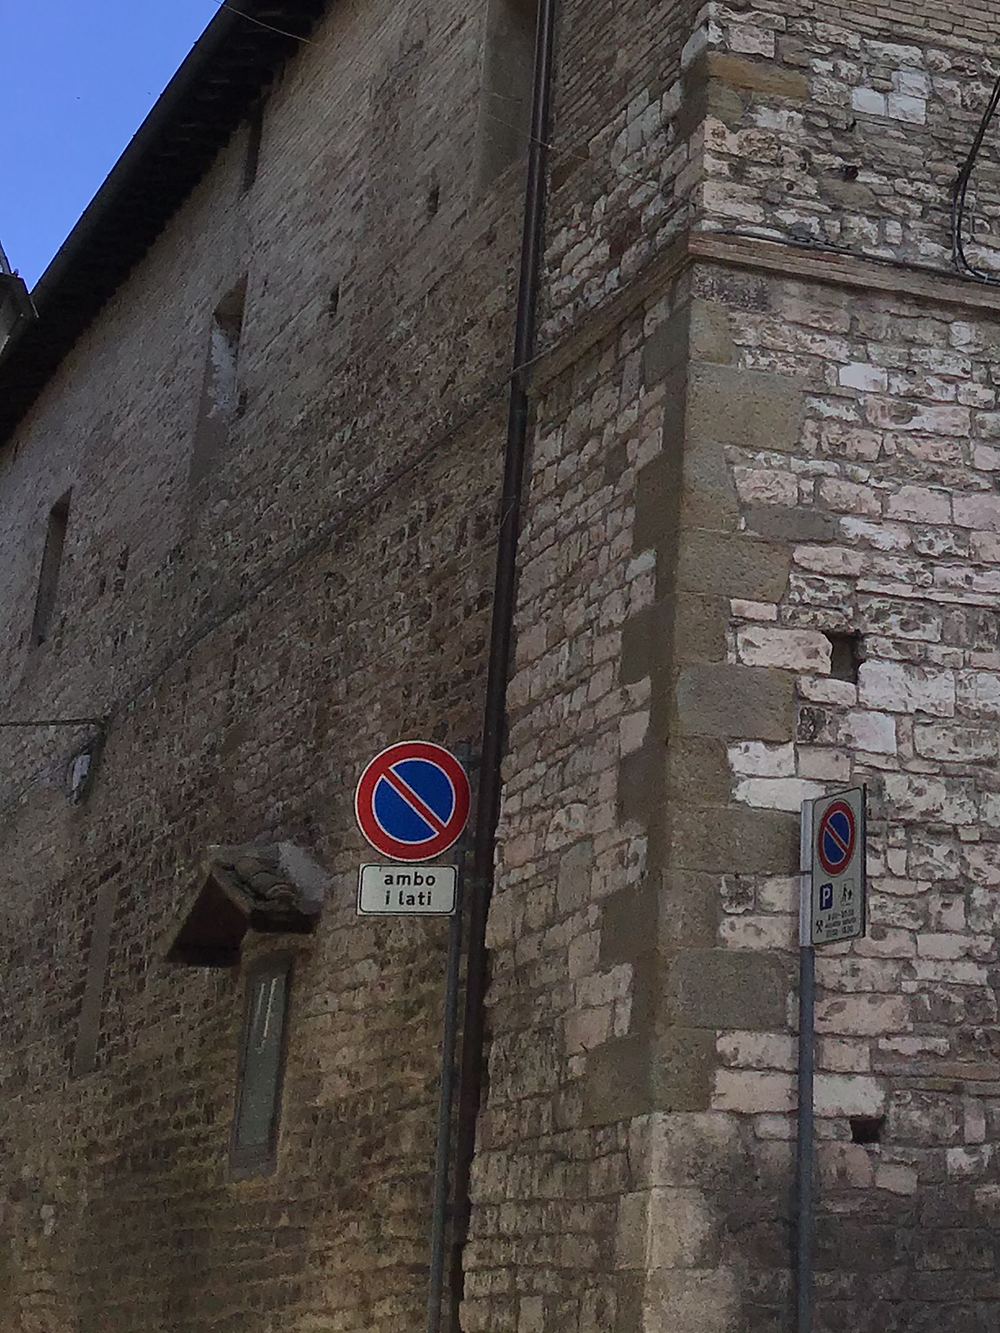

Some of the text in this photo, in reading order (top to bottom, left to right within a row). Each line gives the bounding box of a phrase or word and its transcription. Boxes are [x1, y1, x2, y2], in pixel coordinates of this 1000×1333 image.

[384, 871, 436, 886] ambo
[385, 890, 432, 906] i lati
